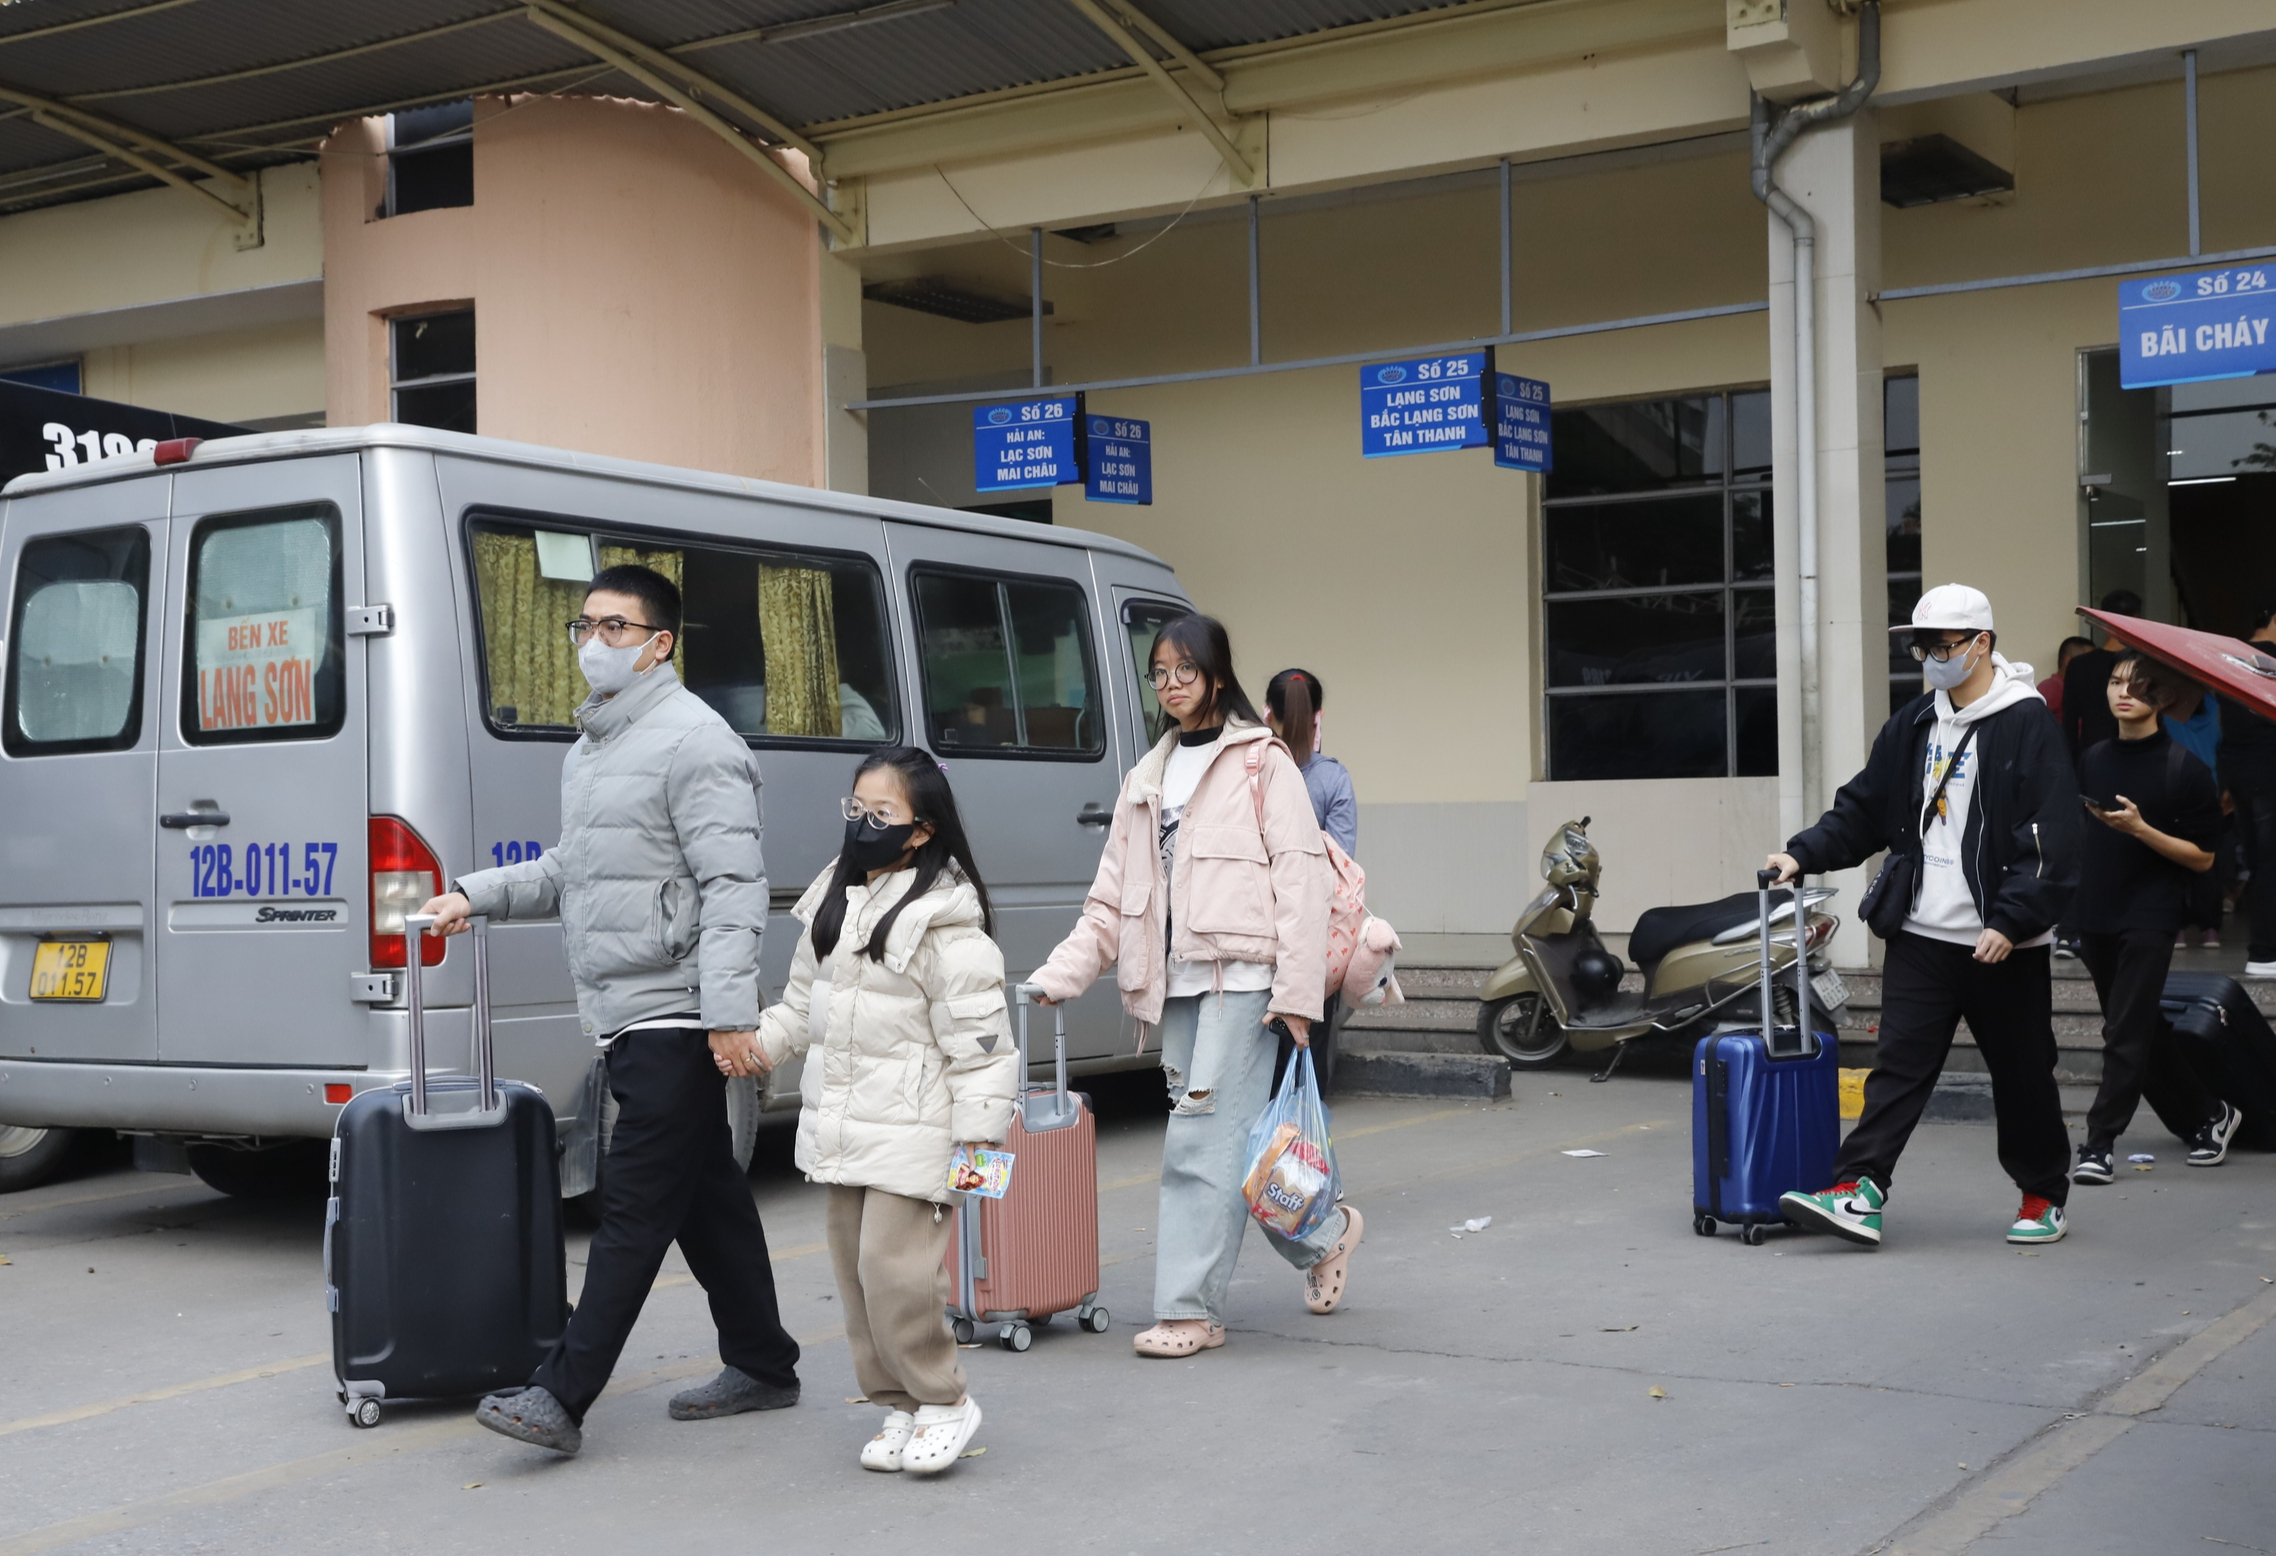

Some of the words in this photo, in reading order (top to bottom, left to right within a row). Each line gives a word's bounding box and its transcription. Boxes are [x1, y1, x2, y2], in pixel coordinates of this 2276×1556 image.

[2197, 271, 2231, 296] Số
[2236, 270, 2267, 291] 24
[2141, 324, 2187, 358] BÃI
[2195, 315, 2270, 351] CHÁY
[1418, 359, 1442, 380] Số
[1446, 359, 1469, 377] 25
[1387, 389, 1425, 409] LẠNG
[1429, 386, 1460, 402] SƠN
[1520, 381, 1531, 399] Số
[1532, 385, 1543, 401] 25
[1021, 403, 1041, 421] Số
[1044, 403, 1063, 419] 26
[1370, 408, 1400, 429] BẮC
[1404, 408, 1443, 427] LẠNG
[1447, 403, 1479, 420] SƠN
[1505, 404, 1524, 422] LẠNG
[1525, 408, 1540, 423] SƠN
[1006, 428, 1024, 443] HẢI
[1027, 429, 1045, 441] AN:
[1115, 421, 1128, 437] Số
[1130, 424, 1142, 439] 26
[1384, 429, 1413, 446] TÂN
[1416, 425, 1466, 443] THANH
[1514, 426, 1532, 443] LẠNG
[1533, 429, 1548, 445] SƠN
[1000, 449, 1023, 465] LẠC
[1027, 445, 1053, 460] SƠN
[1119, 446, 1131, 458] AN:
[1520, 446, 1543, 463] THANH
[997, 467, 1020, 481] MAI
[1024, 462, 1057, 479] CHÂU
[1102, 462, 1117, 477] LẠC
[1119, 463, 1135, 477] SƠN
[1100, 480, 1116, 493] MAI
[1117, 480, 1139, 495] CHÂU
[228, 617, 261, 651] BẾN
[267, 620, 289, 647] XE
[200, 664, 257, 730] LANG
[264, 655, 311, 725] SƠN
[57, 944, 87, 968] 12B
[37, 972, 97, 996] 011.57
[1267, 1182, 1304, 1212] Staff
